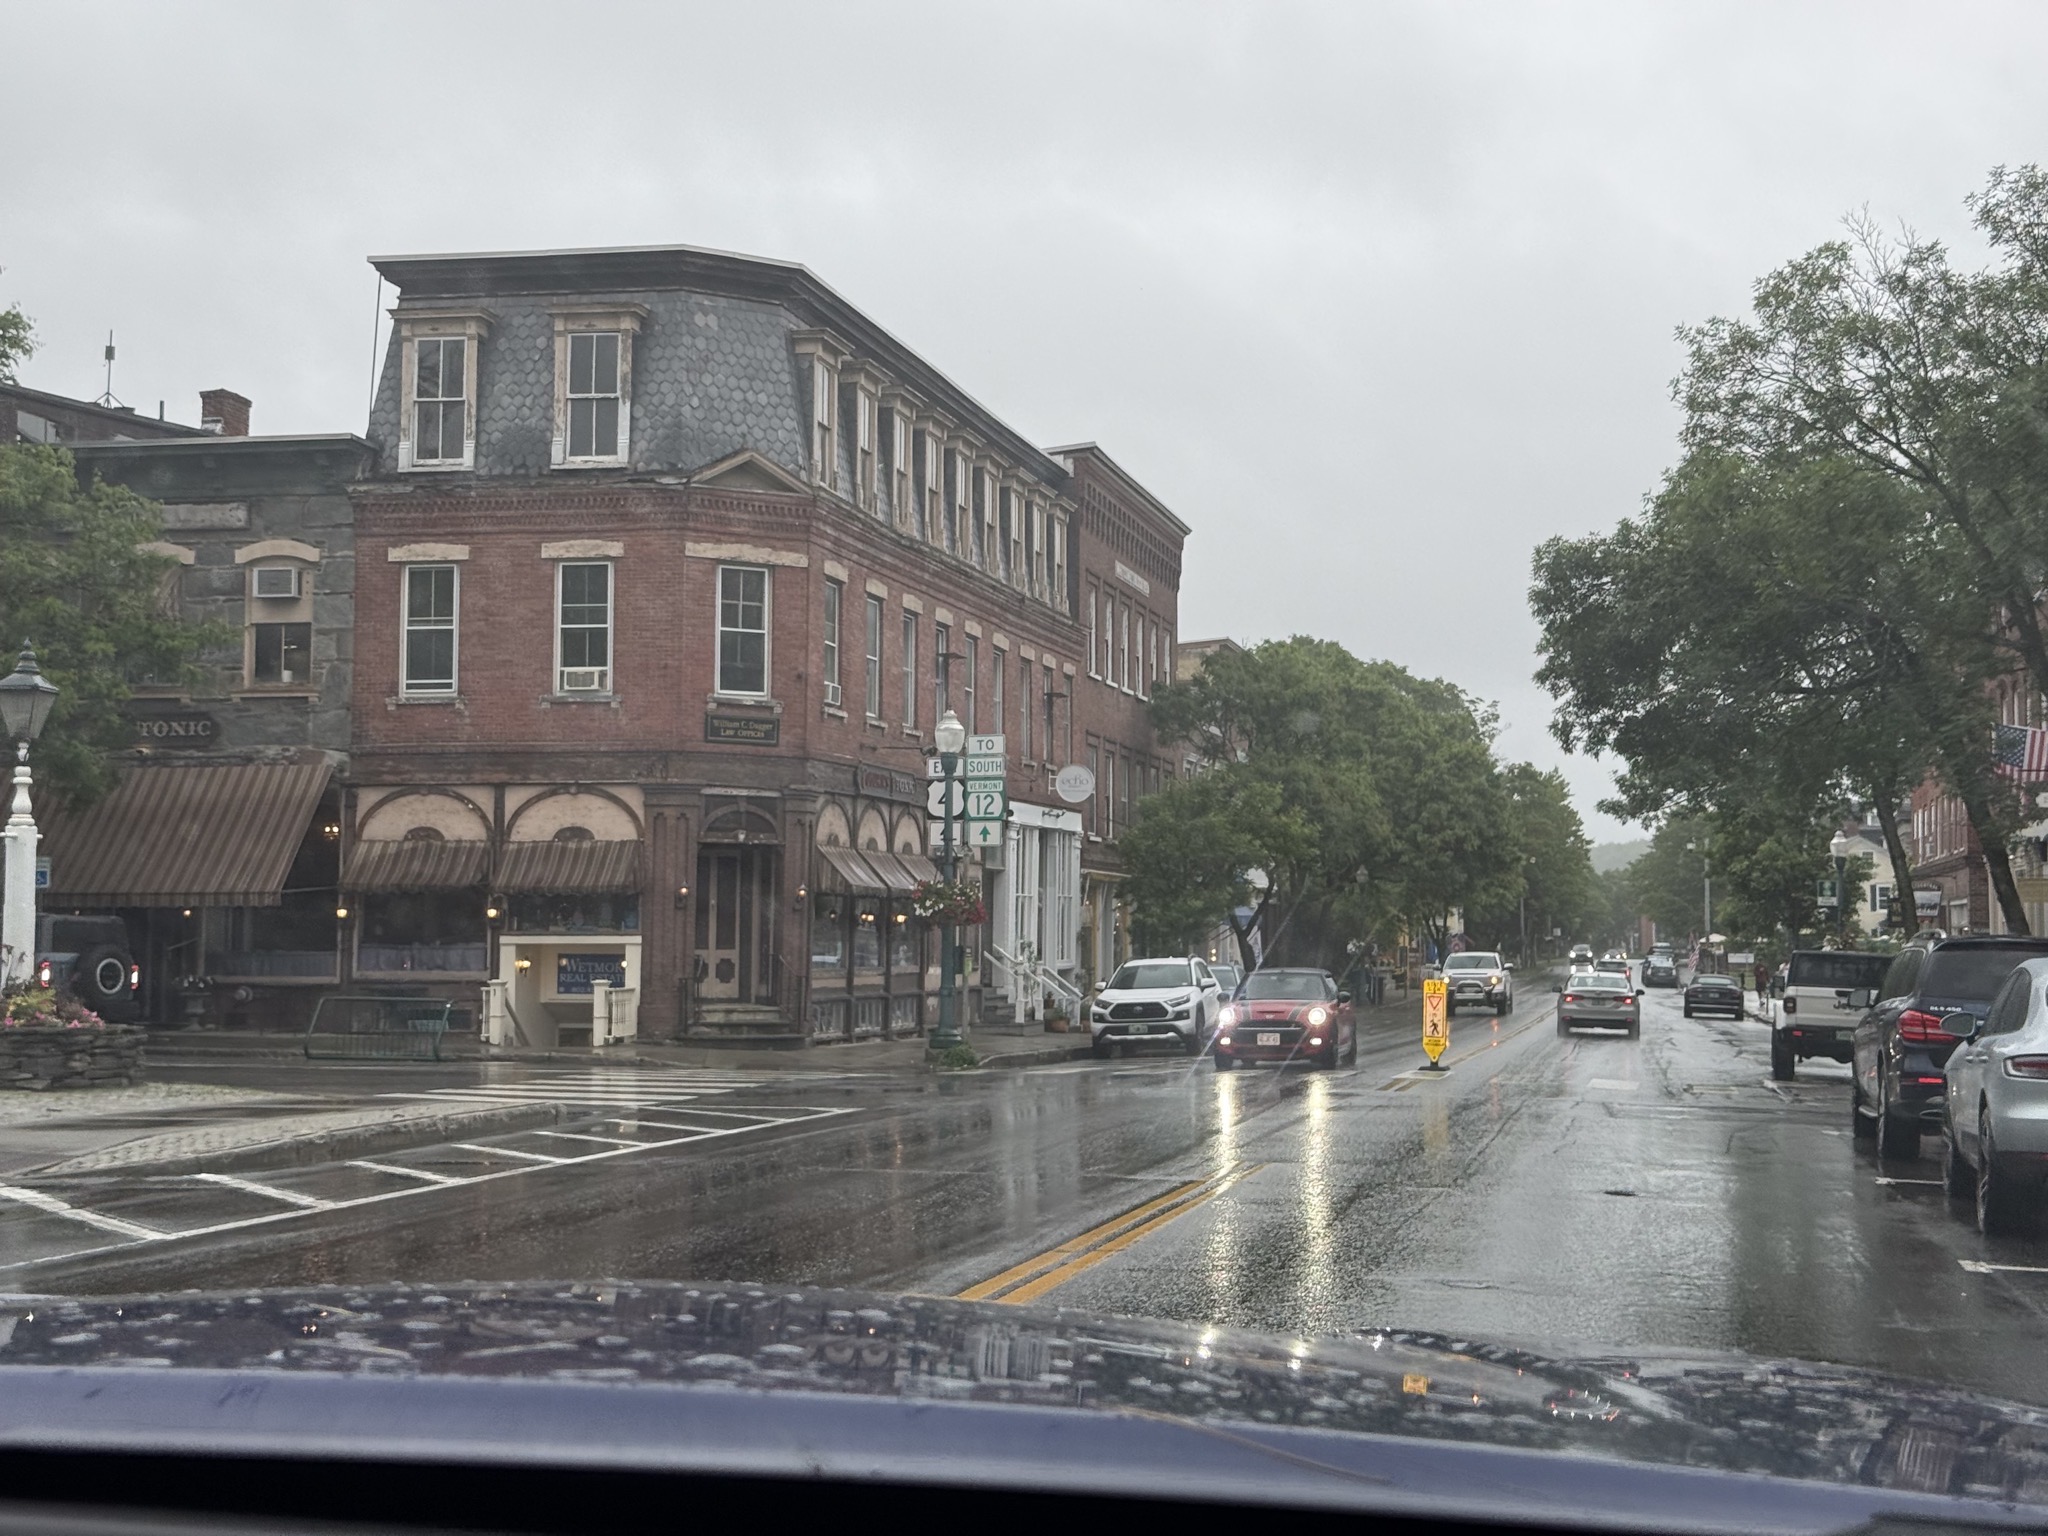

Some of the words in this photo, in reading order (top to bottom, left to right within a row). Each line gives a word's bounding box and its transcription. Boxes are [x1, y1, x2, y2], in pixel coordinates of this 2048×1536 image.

[977, 739, 995, 751] TO
[968, 760, 1002, 773] SOUTH
[969, 781, 1001, 791] VERMONT
[975, 793, 995, 816] 12
[564, 958, 623, 973] WETMOR
[560, 973, 587, 983] REAL
[589, 973, 625, 983] ESTAT
